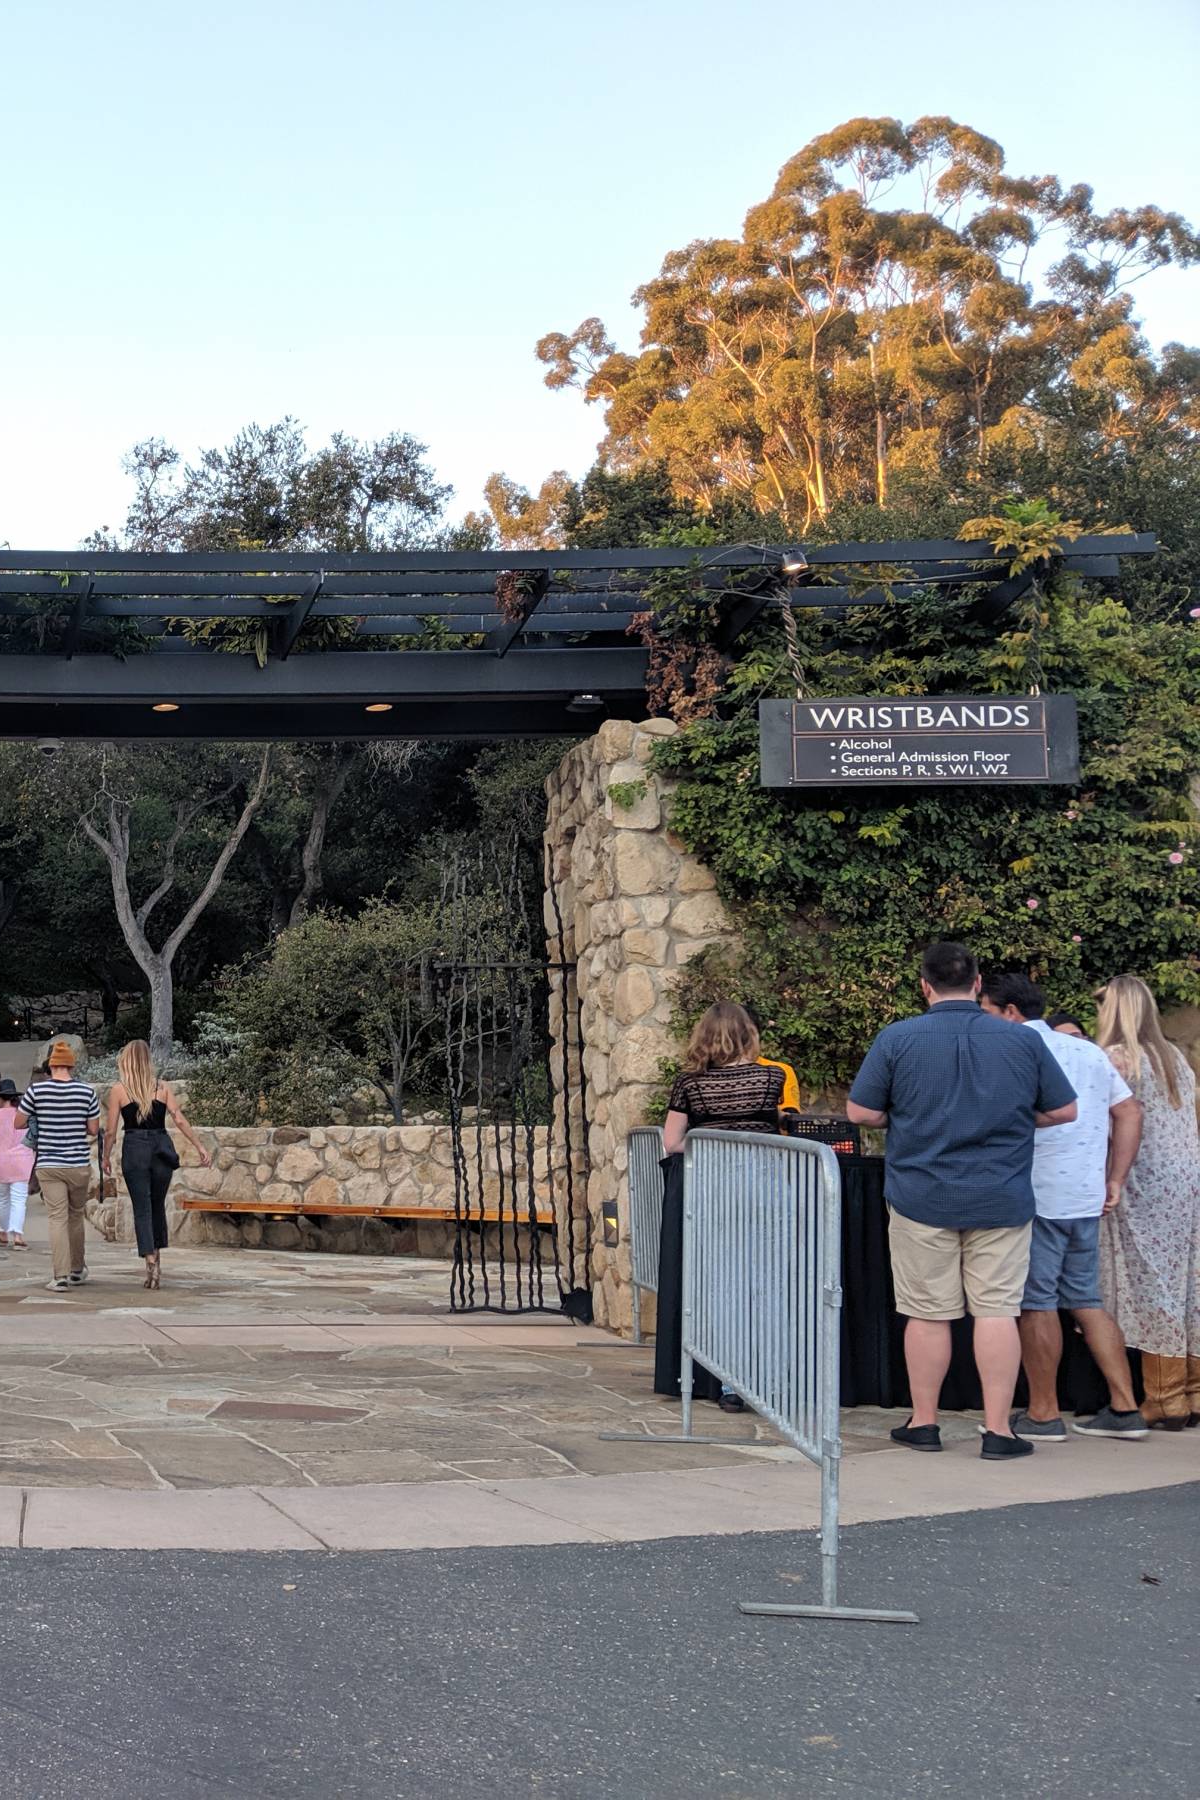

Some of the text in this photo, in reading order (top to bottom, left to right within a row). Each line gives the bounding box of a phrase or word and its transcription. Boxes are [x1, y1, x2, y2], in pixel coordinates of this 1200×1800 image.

[809, 705, 1031, 729] WRISTBANDS
[838, 738, 892, 750] Alcohol
[840, 750, 1011, 763] General Admission Floor
[840, 765, 898, 777] Sections
[981, 763, 1009, 776] W2
